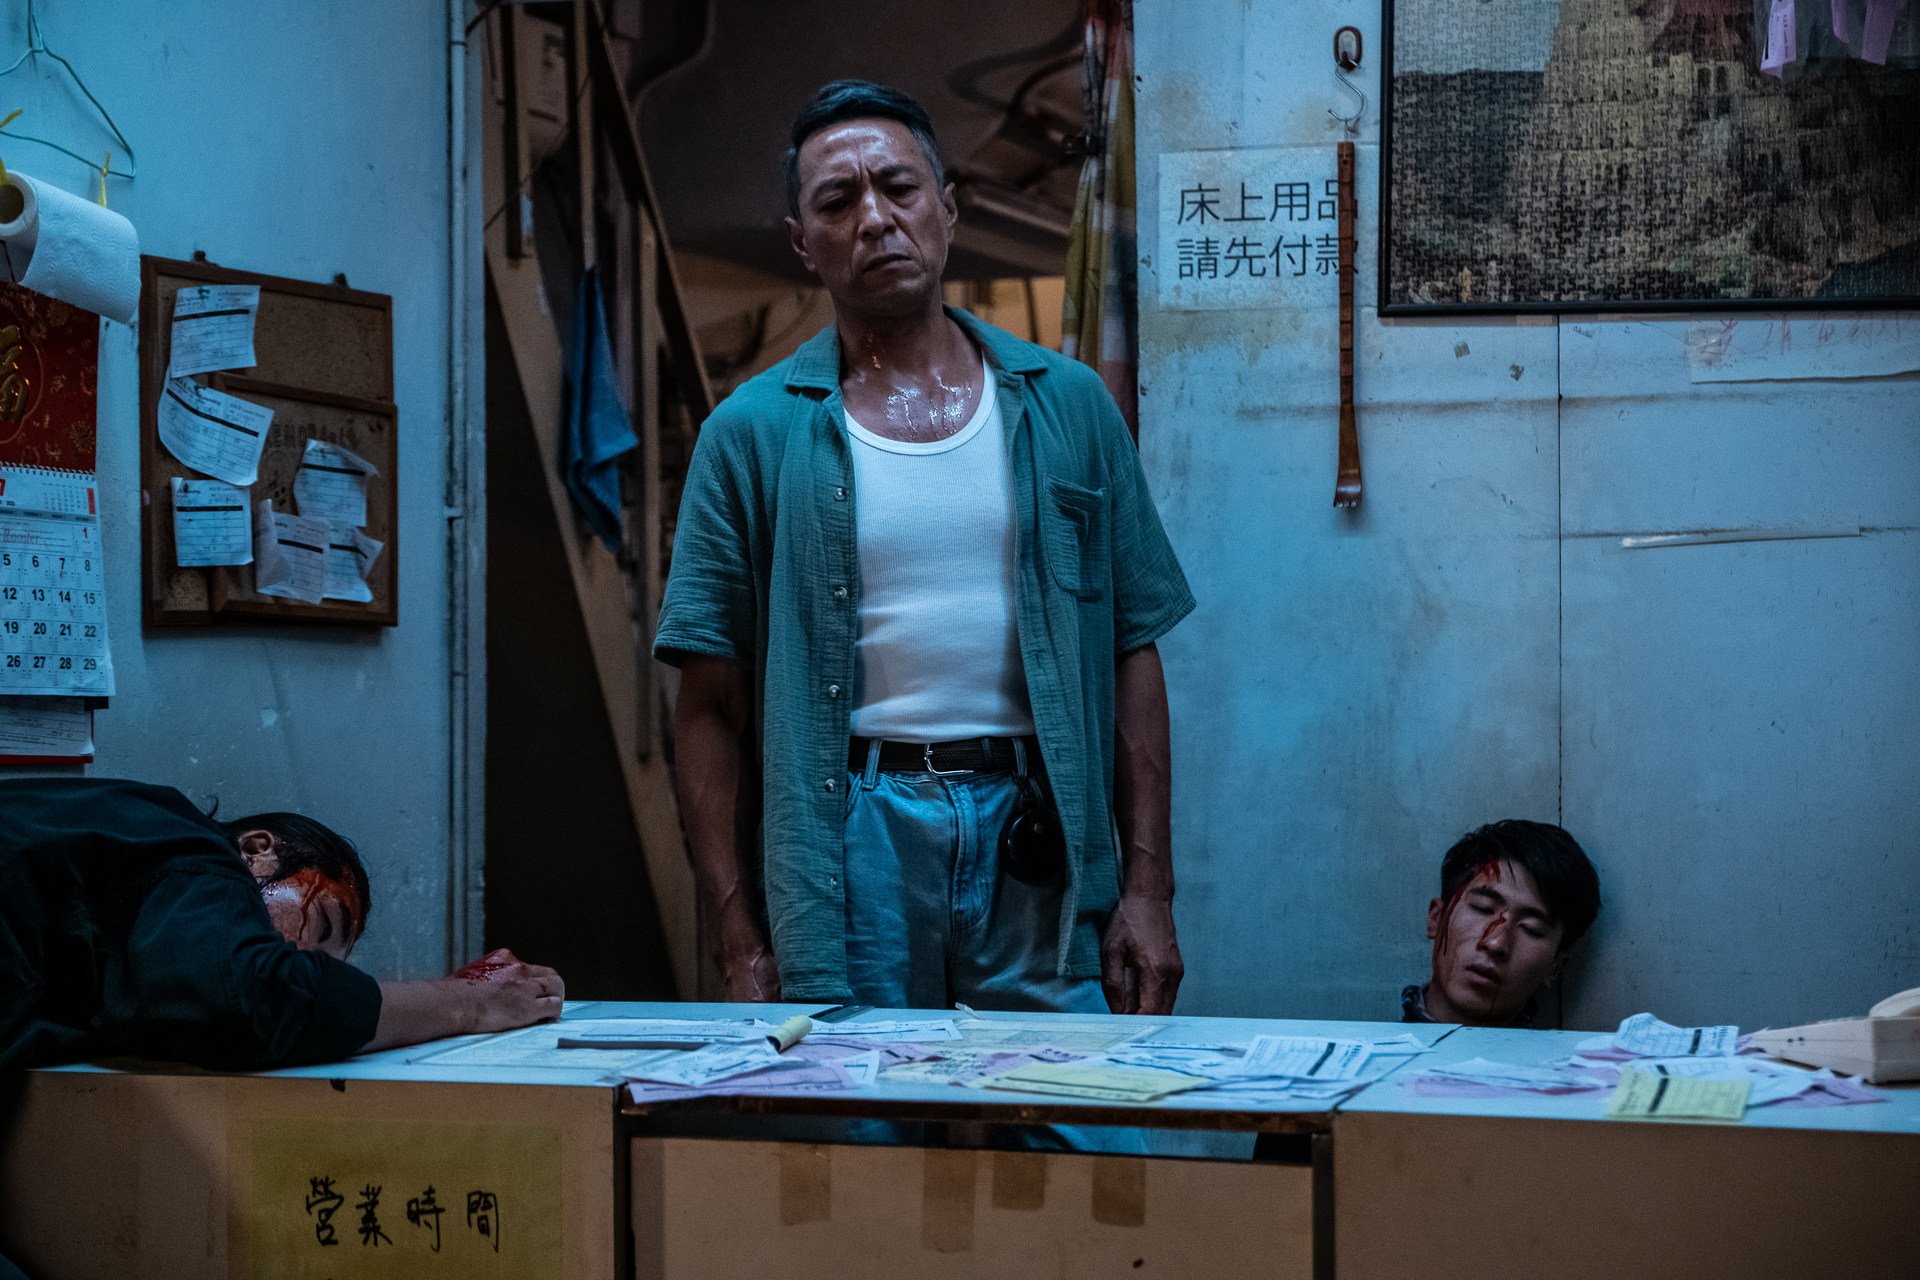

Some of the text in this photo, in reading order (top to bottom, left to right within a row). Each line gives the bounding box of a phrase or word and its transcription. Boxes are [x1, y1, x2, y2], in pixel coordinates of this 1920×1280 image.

[83, 527, 88, 539] 1
[3, 554, 91, 572] 5 6 7 8
[2, 587, 96, 605] 12 13 14 15
[4, 621, 96, 638] 19 20 21 22
[6, 655, 97, 670] 26 27 28 29
[306, 1176, 499, 1253] 營業時間
